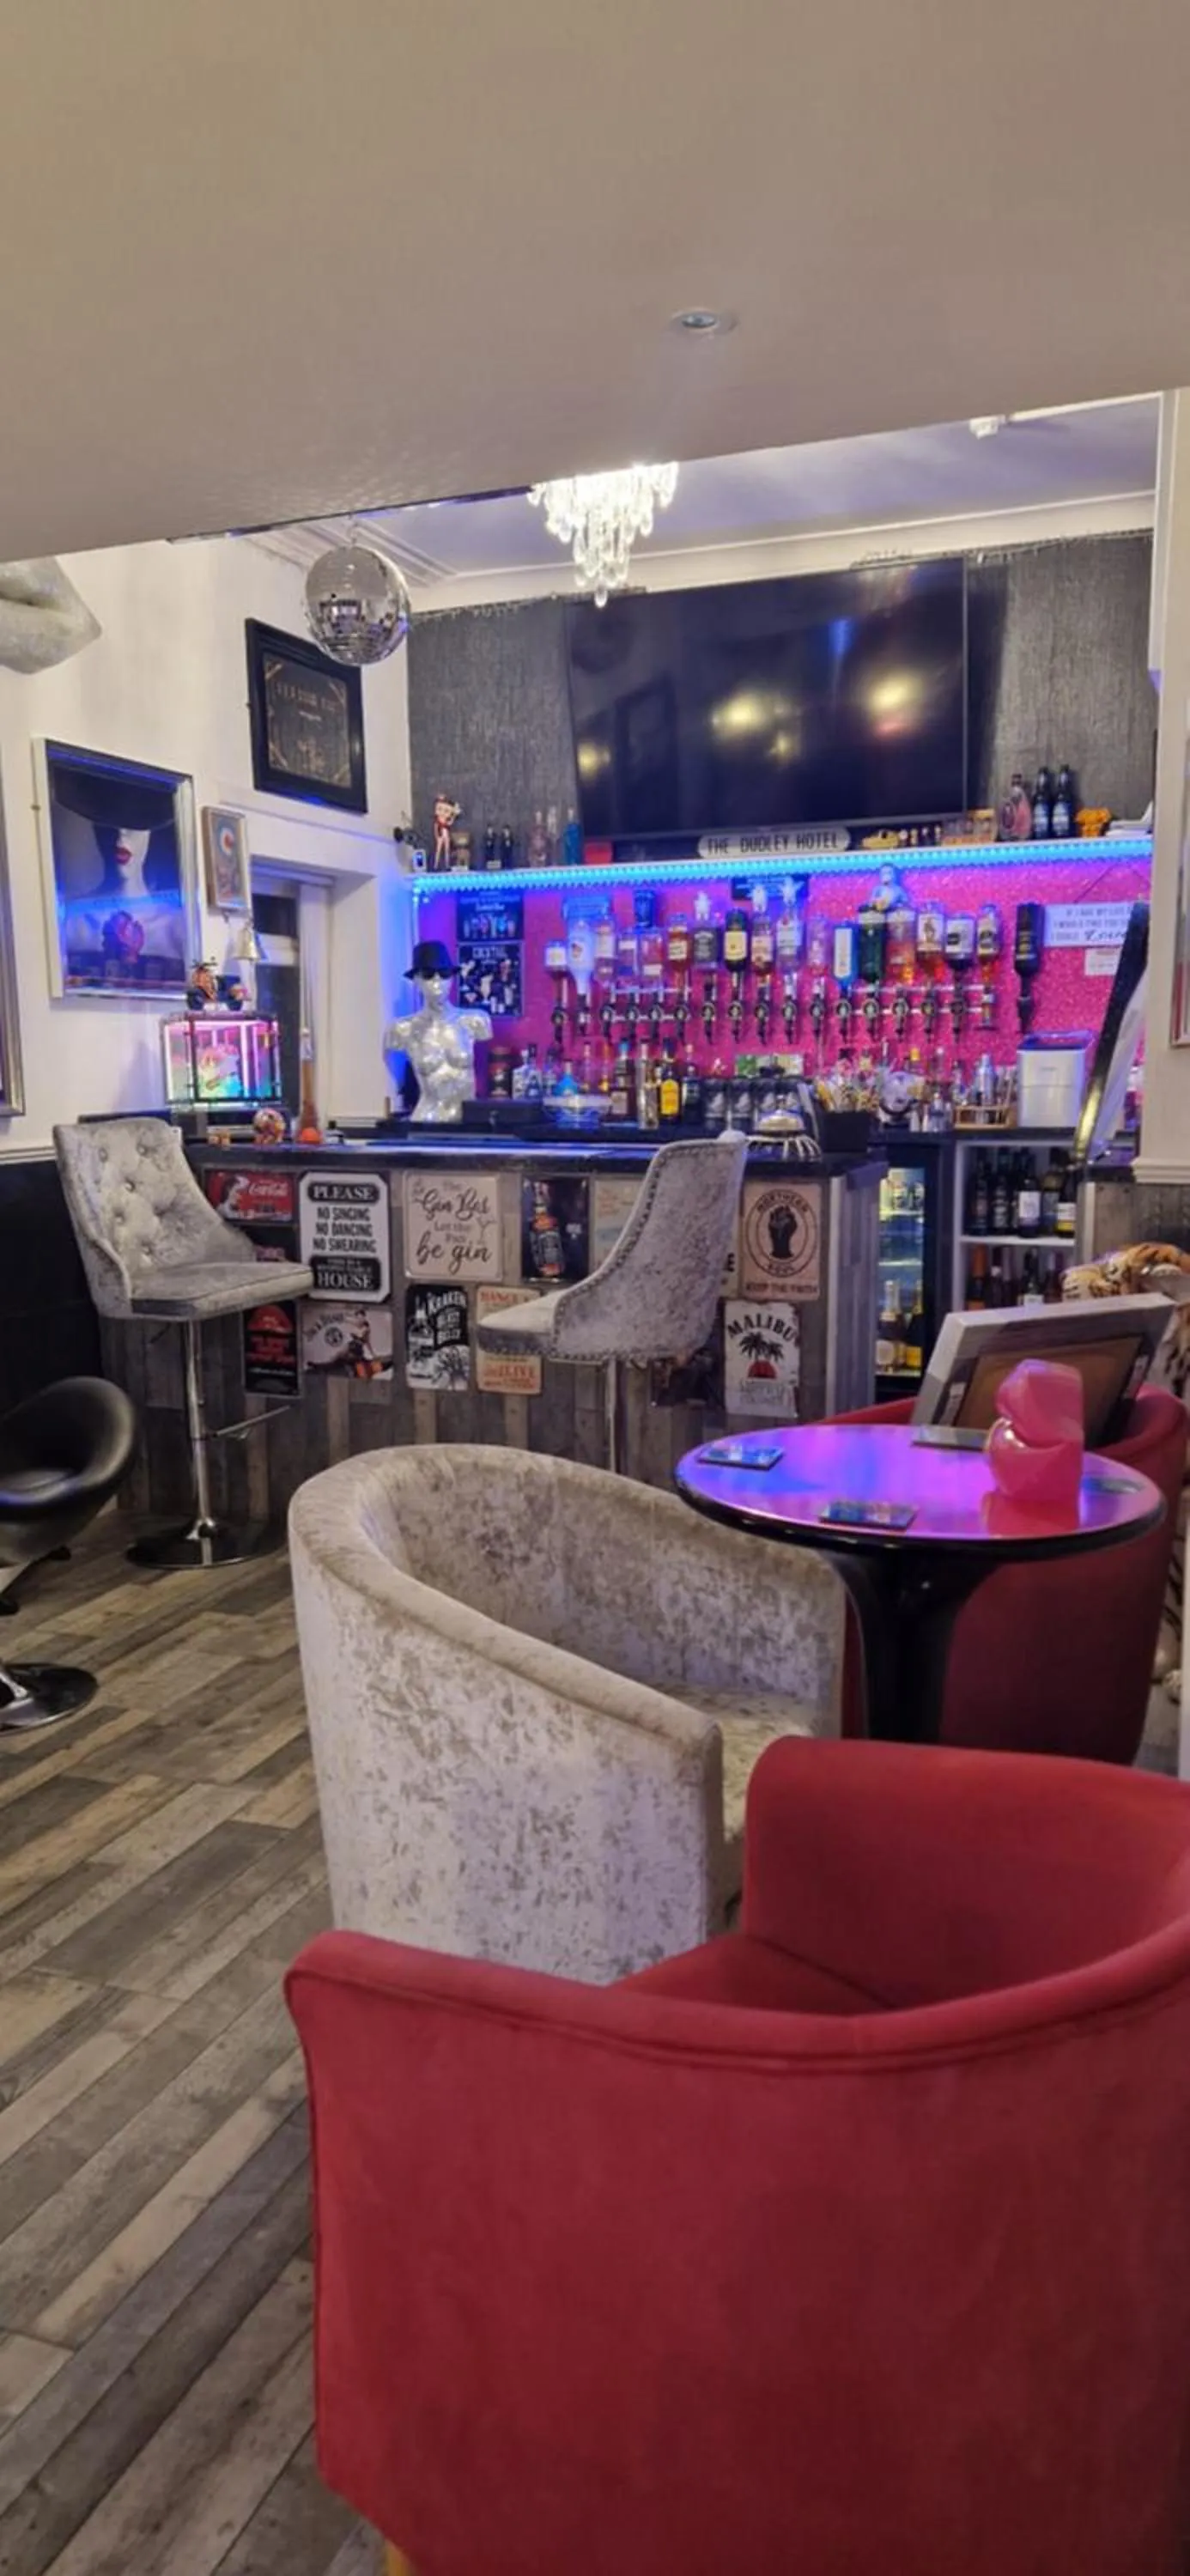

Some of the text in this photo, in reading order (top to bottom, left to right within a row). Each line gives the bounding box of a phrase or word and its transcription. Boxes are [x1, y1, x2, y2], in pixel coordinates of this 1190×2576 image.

[707, 831, 837, 854] THE DUDLEY HOTEL
[313, 1186, 373, 1200] PLEASE
[756, 1192, 808, 1212] NORTHERN
[317, 1206, 371, 1221] NO SINGING
[414, 1187, 489, 1221] Gin Bar
[316, 1222, 372, 1237] NO DANCING
[313, 1237, 376, 1253] NO SWEARING
[416, 1230, 493, 1276] be gin
[317, 1272, 373, 1288] HOUSE
[428, 1291, 467, 1315] KRAKEN
[727, 1314, 798, 1342] MALIBU
